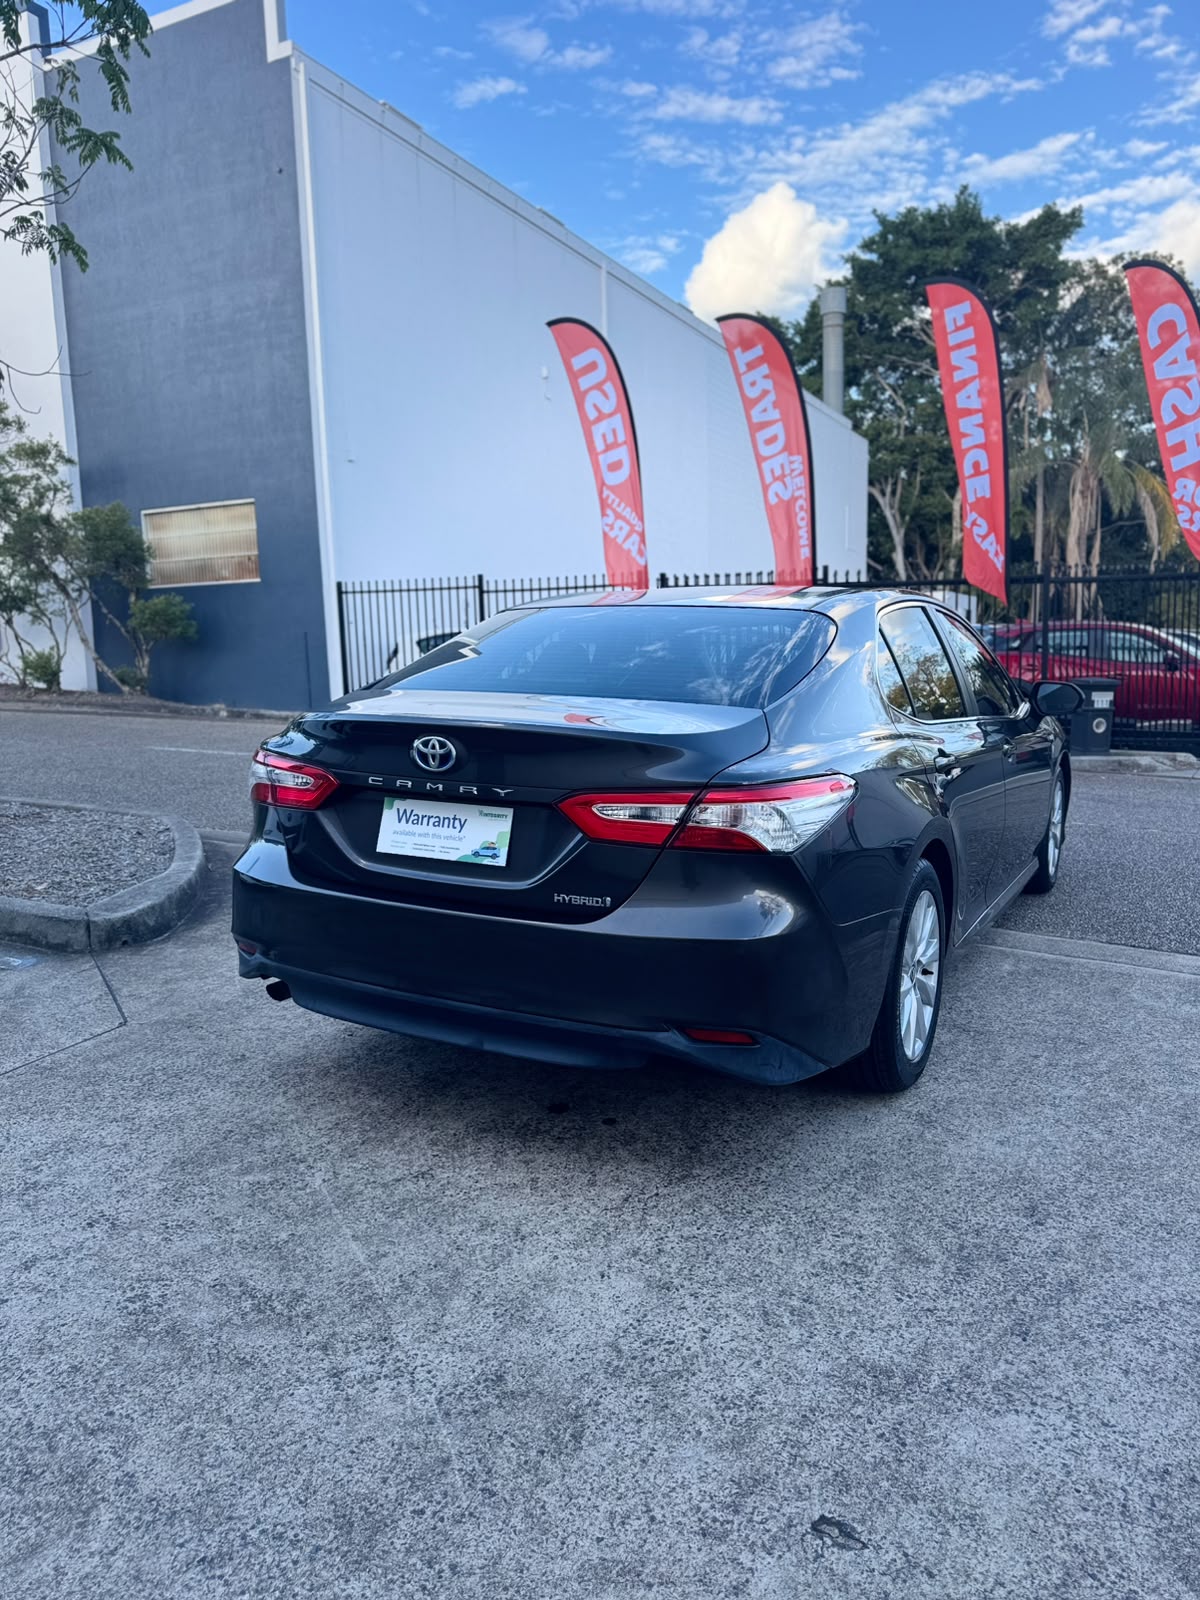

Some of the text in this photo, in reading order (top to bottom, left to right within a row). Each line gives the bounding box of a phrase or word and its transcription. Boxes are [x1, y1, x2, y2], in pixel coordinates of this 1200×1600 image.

[368, 776, 514, 797] CAMRY
[396, 807, 468, 833] Warranty
[392, 828, 416, 837] available
[417, 831, 431, 839] with
[431, 832, 442, 840] this
